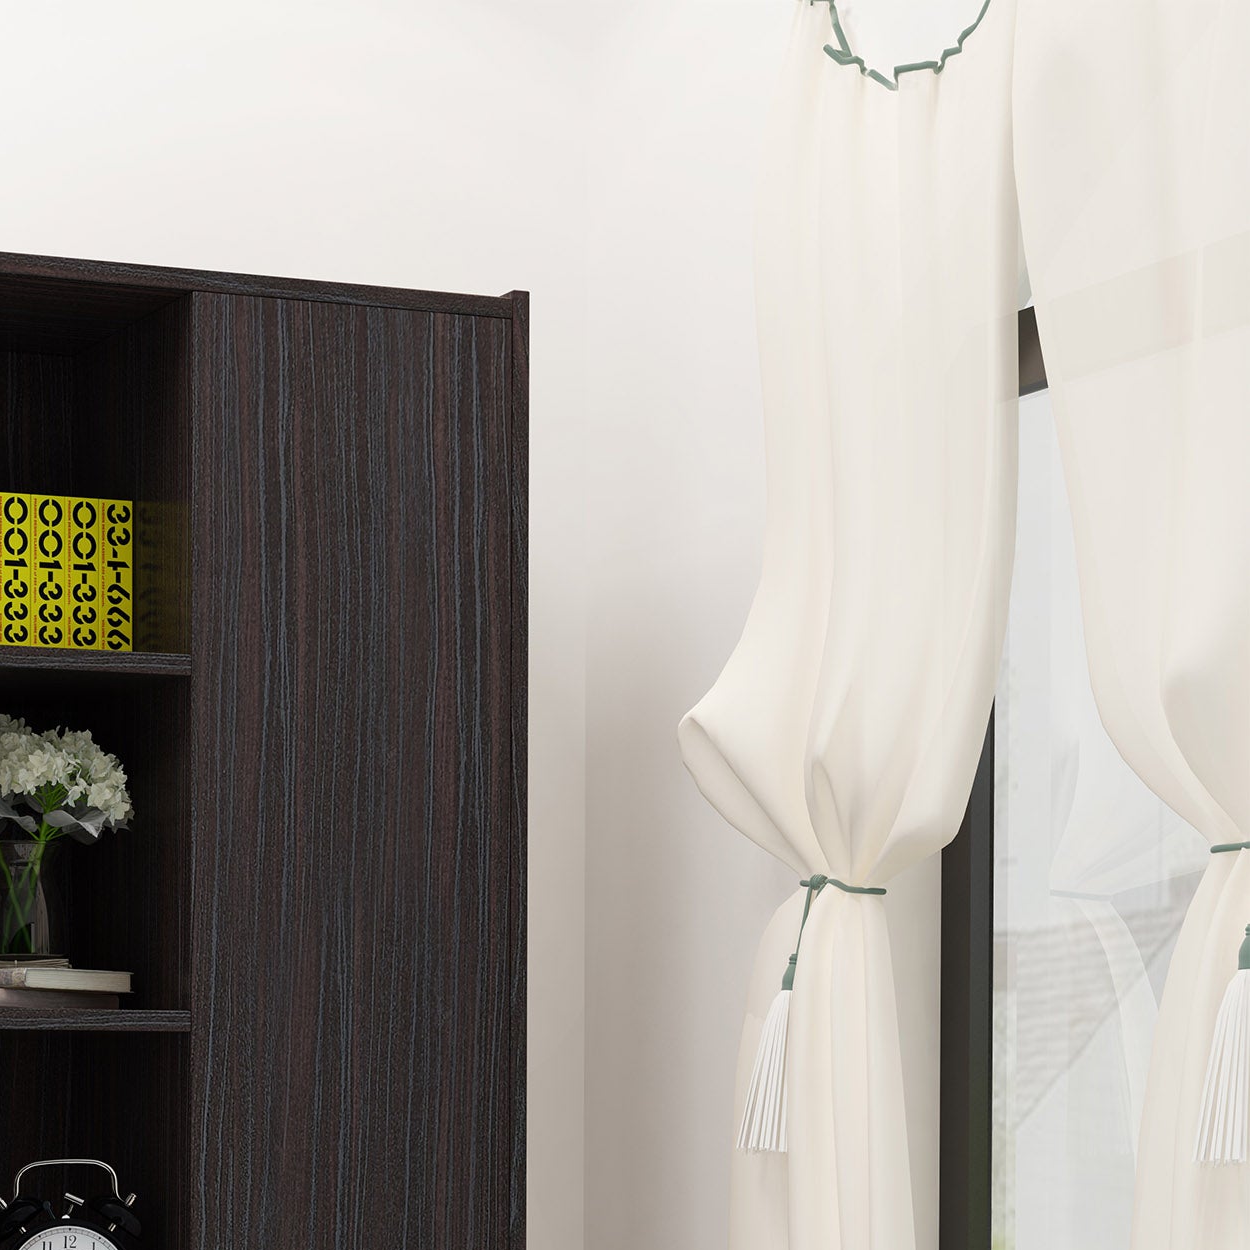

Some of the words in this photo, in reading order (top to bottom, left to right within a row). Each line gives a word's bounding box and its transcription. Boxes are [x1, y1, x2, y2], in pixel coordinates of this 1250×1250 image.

[4, 496, 28, 643] 001-333
[38, 499, 63, 645] 001-333
[72, 501, 96, 647] 001-333
[107, 504, 130, 650] 334-666
[64, 1235, 77, 1248] 12
